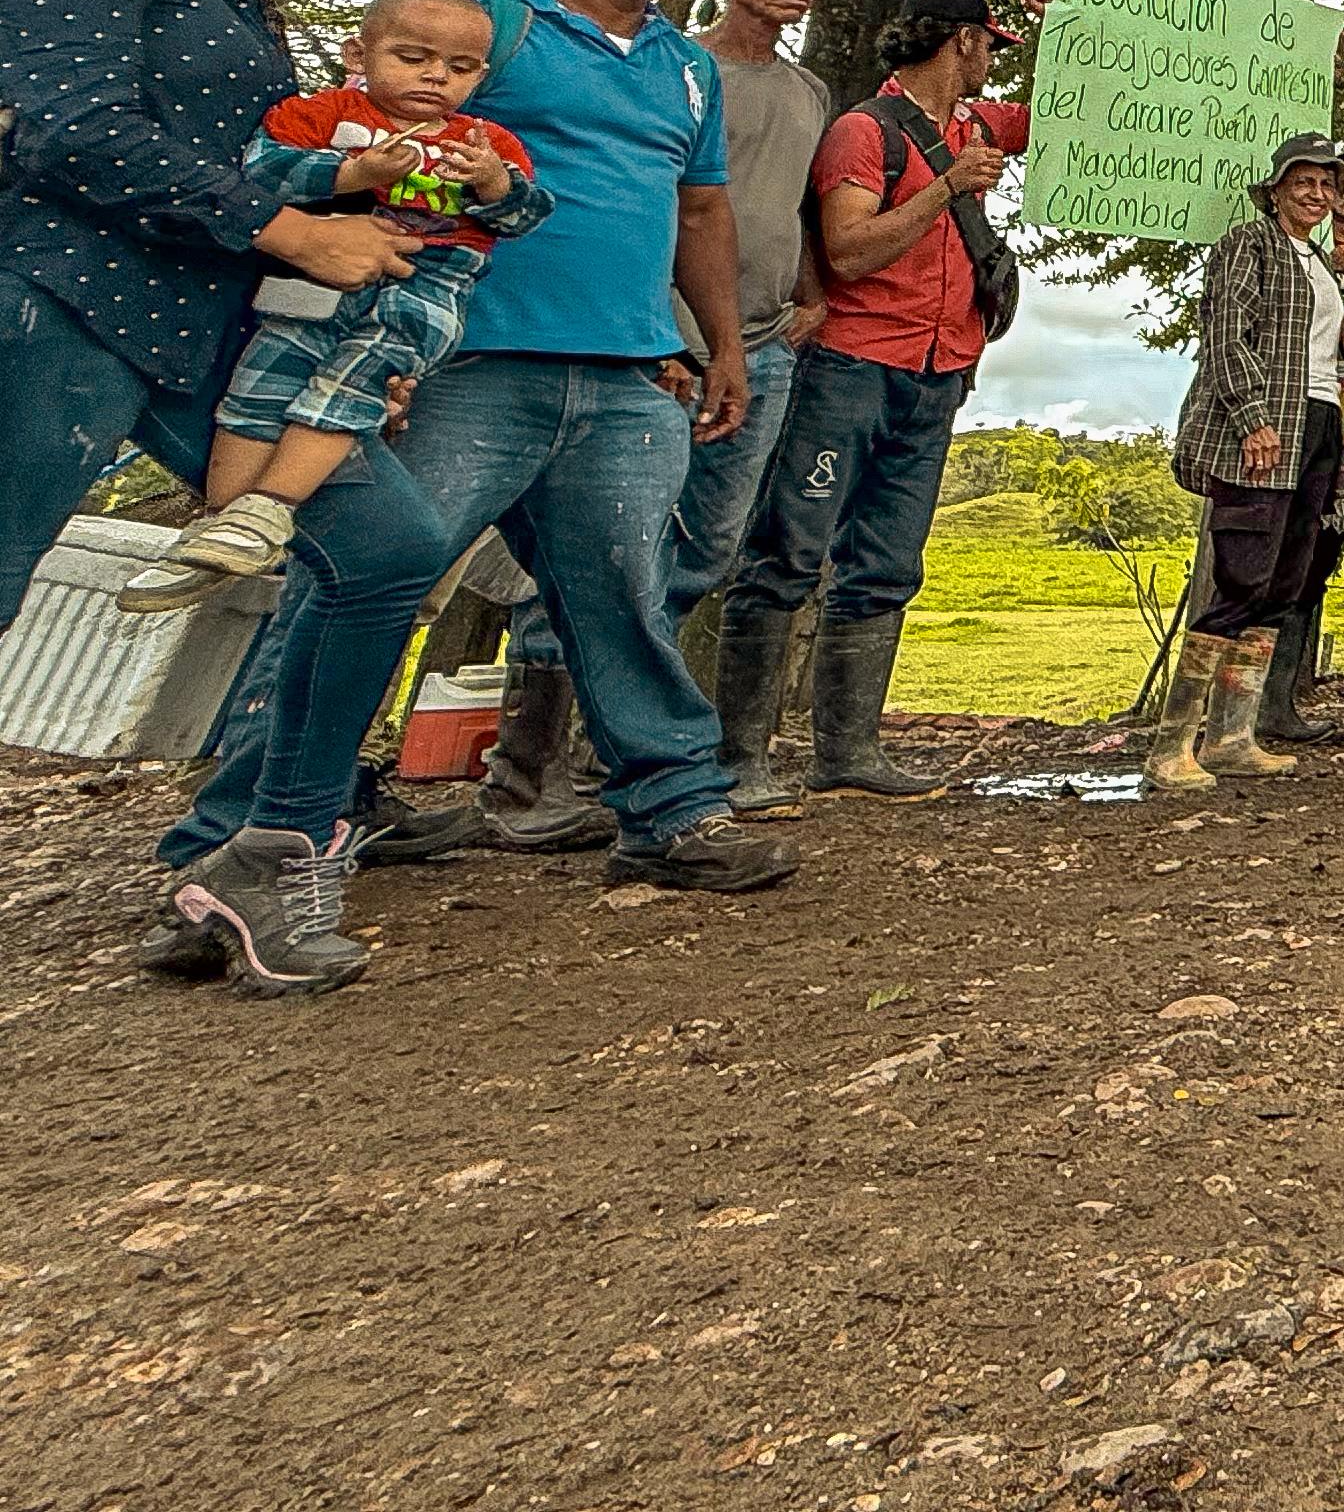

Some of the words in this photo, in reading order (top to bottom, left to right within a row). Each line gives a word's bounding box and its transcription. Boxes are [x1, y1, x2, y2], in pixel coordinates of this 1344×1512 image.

[1261, 0, 1294, 50] de
[1045, 16, 1237, 91] Trabajadores
[1037, 81, 1085, 121] del
[1107, 90, 1193, 138] Carare
[1067, 140, 1203, 191] Magdalena
[1046, 184, 1191, 232] Colombia
